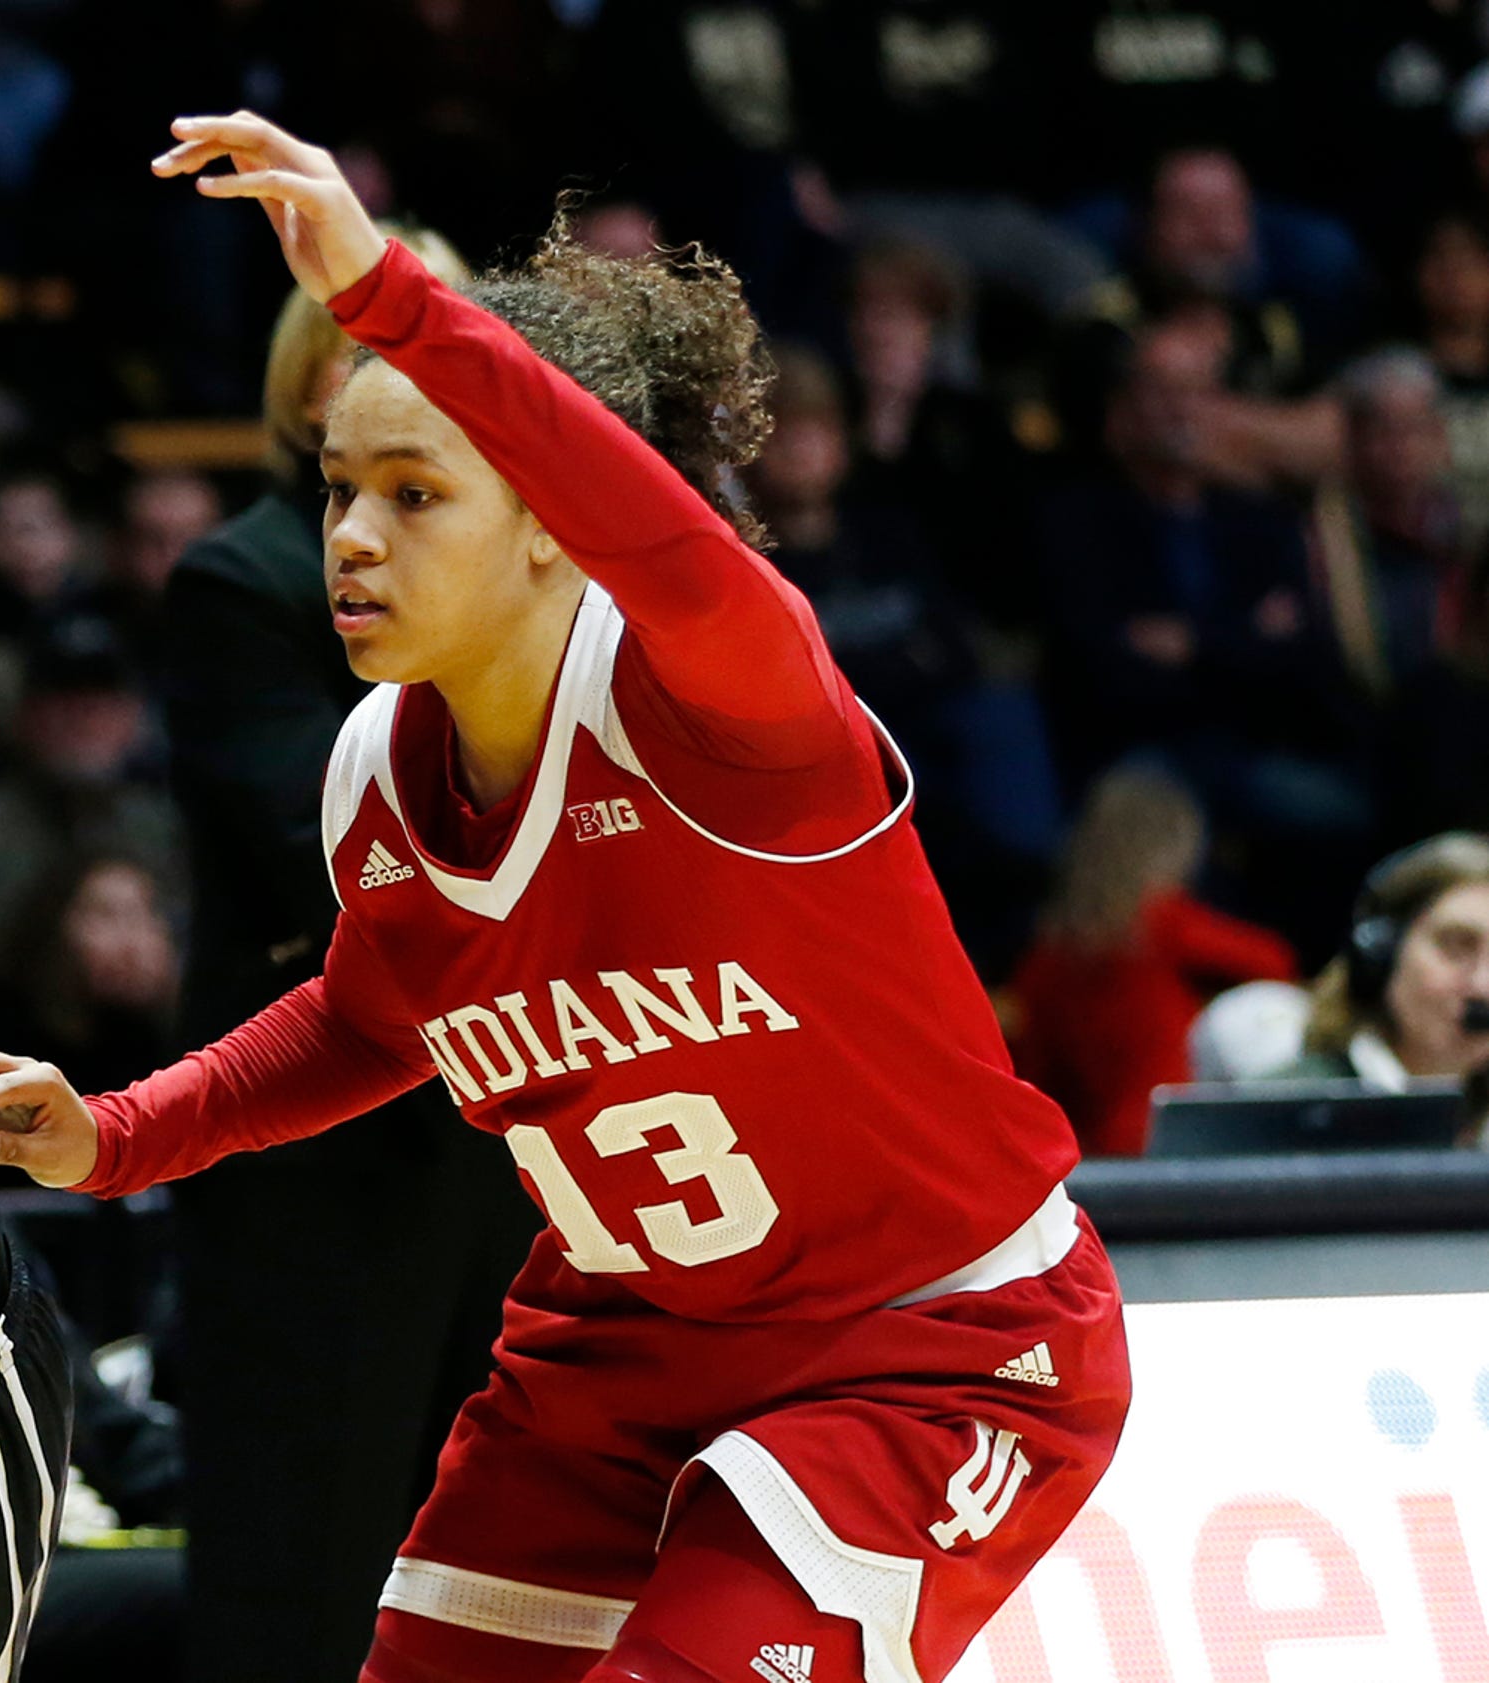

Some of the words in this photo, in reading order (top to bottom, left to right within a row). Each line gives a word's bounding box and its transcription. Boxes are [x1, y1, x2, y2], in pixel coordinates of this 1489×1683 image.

[359, 864, 415, 890] adidas
[416, 961, 800, 1107] NDIANA
[504, 1091, 780, 1273] 13
[994, 1366, 1060, 1387] adidas
